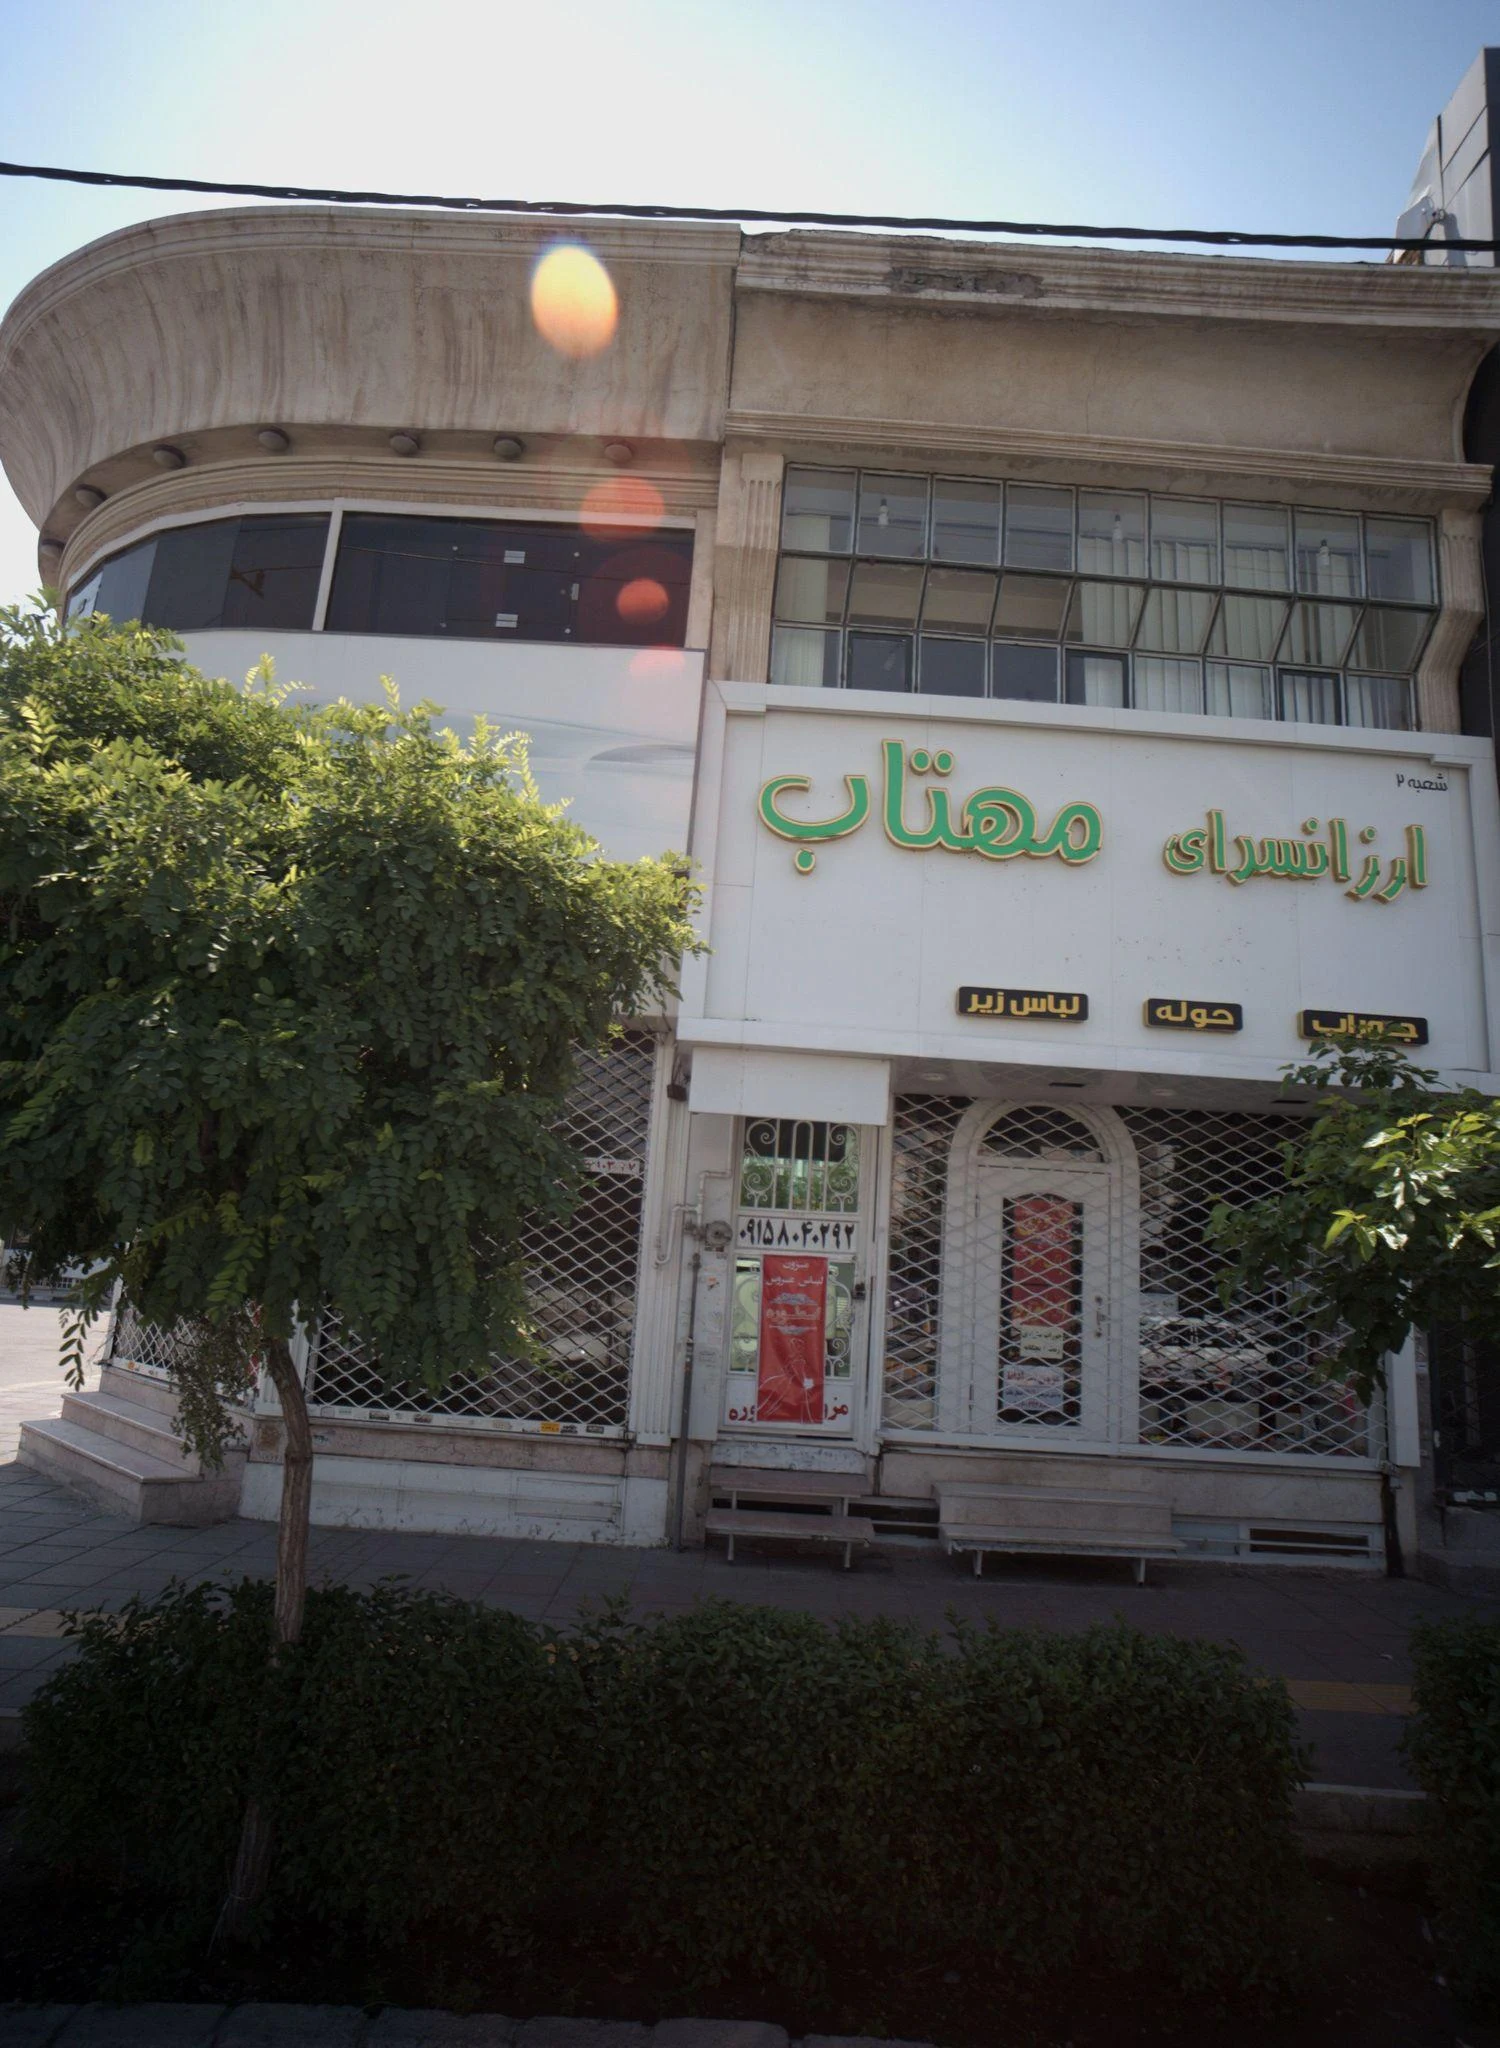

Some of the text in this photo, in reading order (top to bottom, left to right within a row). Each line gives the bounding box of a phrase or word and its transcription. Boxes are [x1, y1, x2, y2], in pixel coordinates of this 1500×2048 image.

[1407, 773, 1449, 793] شعبه
[757, 738, 1428, 904] ارزانسرای مهتاب
[967, 991, 1080, 1018] لباس زیر
[1155, 1001, 1234, 1028] حوله
[740, 1218, 855, 1250] ۰۹۱۵۸۰۴۰۲۹۲
